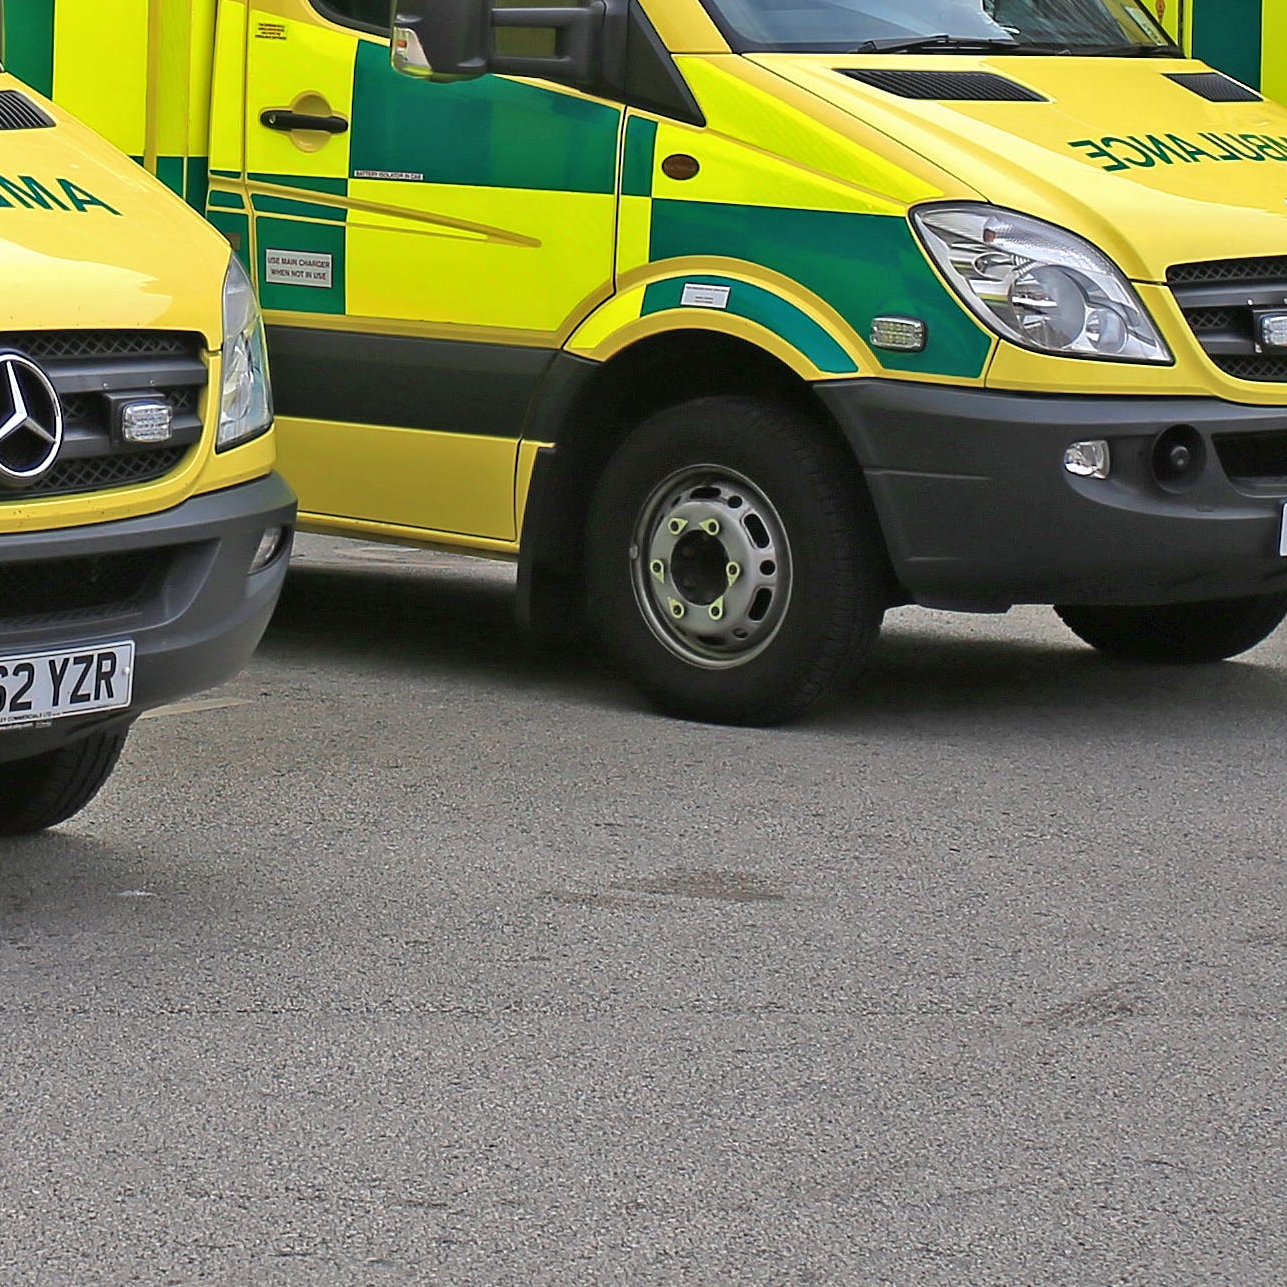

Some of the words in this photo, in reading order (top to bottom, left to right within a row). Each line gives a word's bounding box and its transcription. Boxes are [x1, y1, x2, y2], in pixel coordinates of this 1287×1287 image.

[291, 270, 304, 278] NOT
[305, 271, 312, 279] IN
[313, 272, 327, 281] USE
[48, 651, 117, 707] YZR
